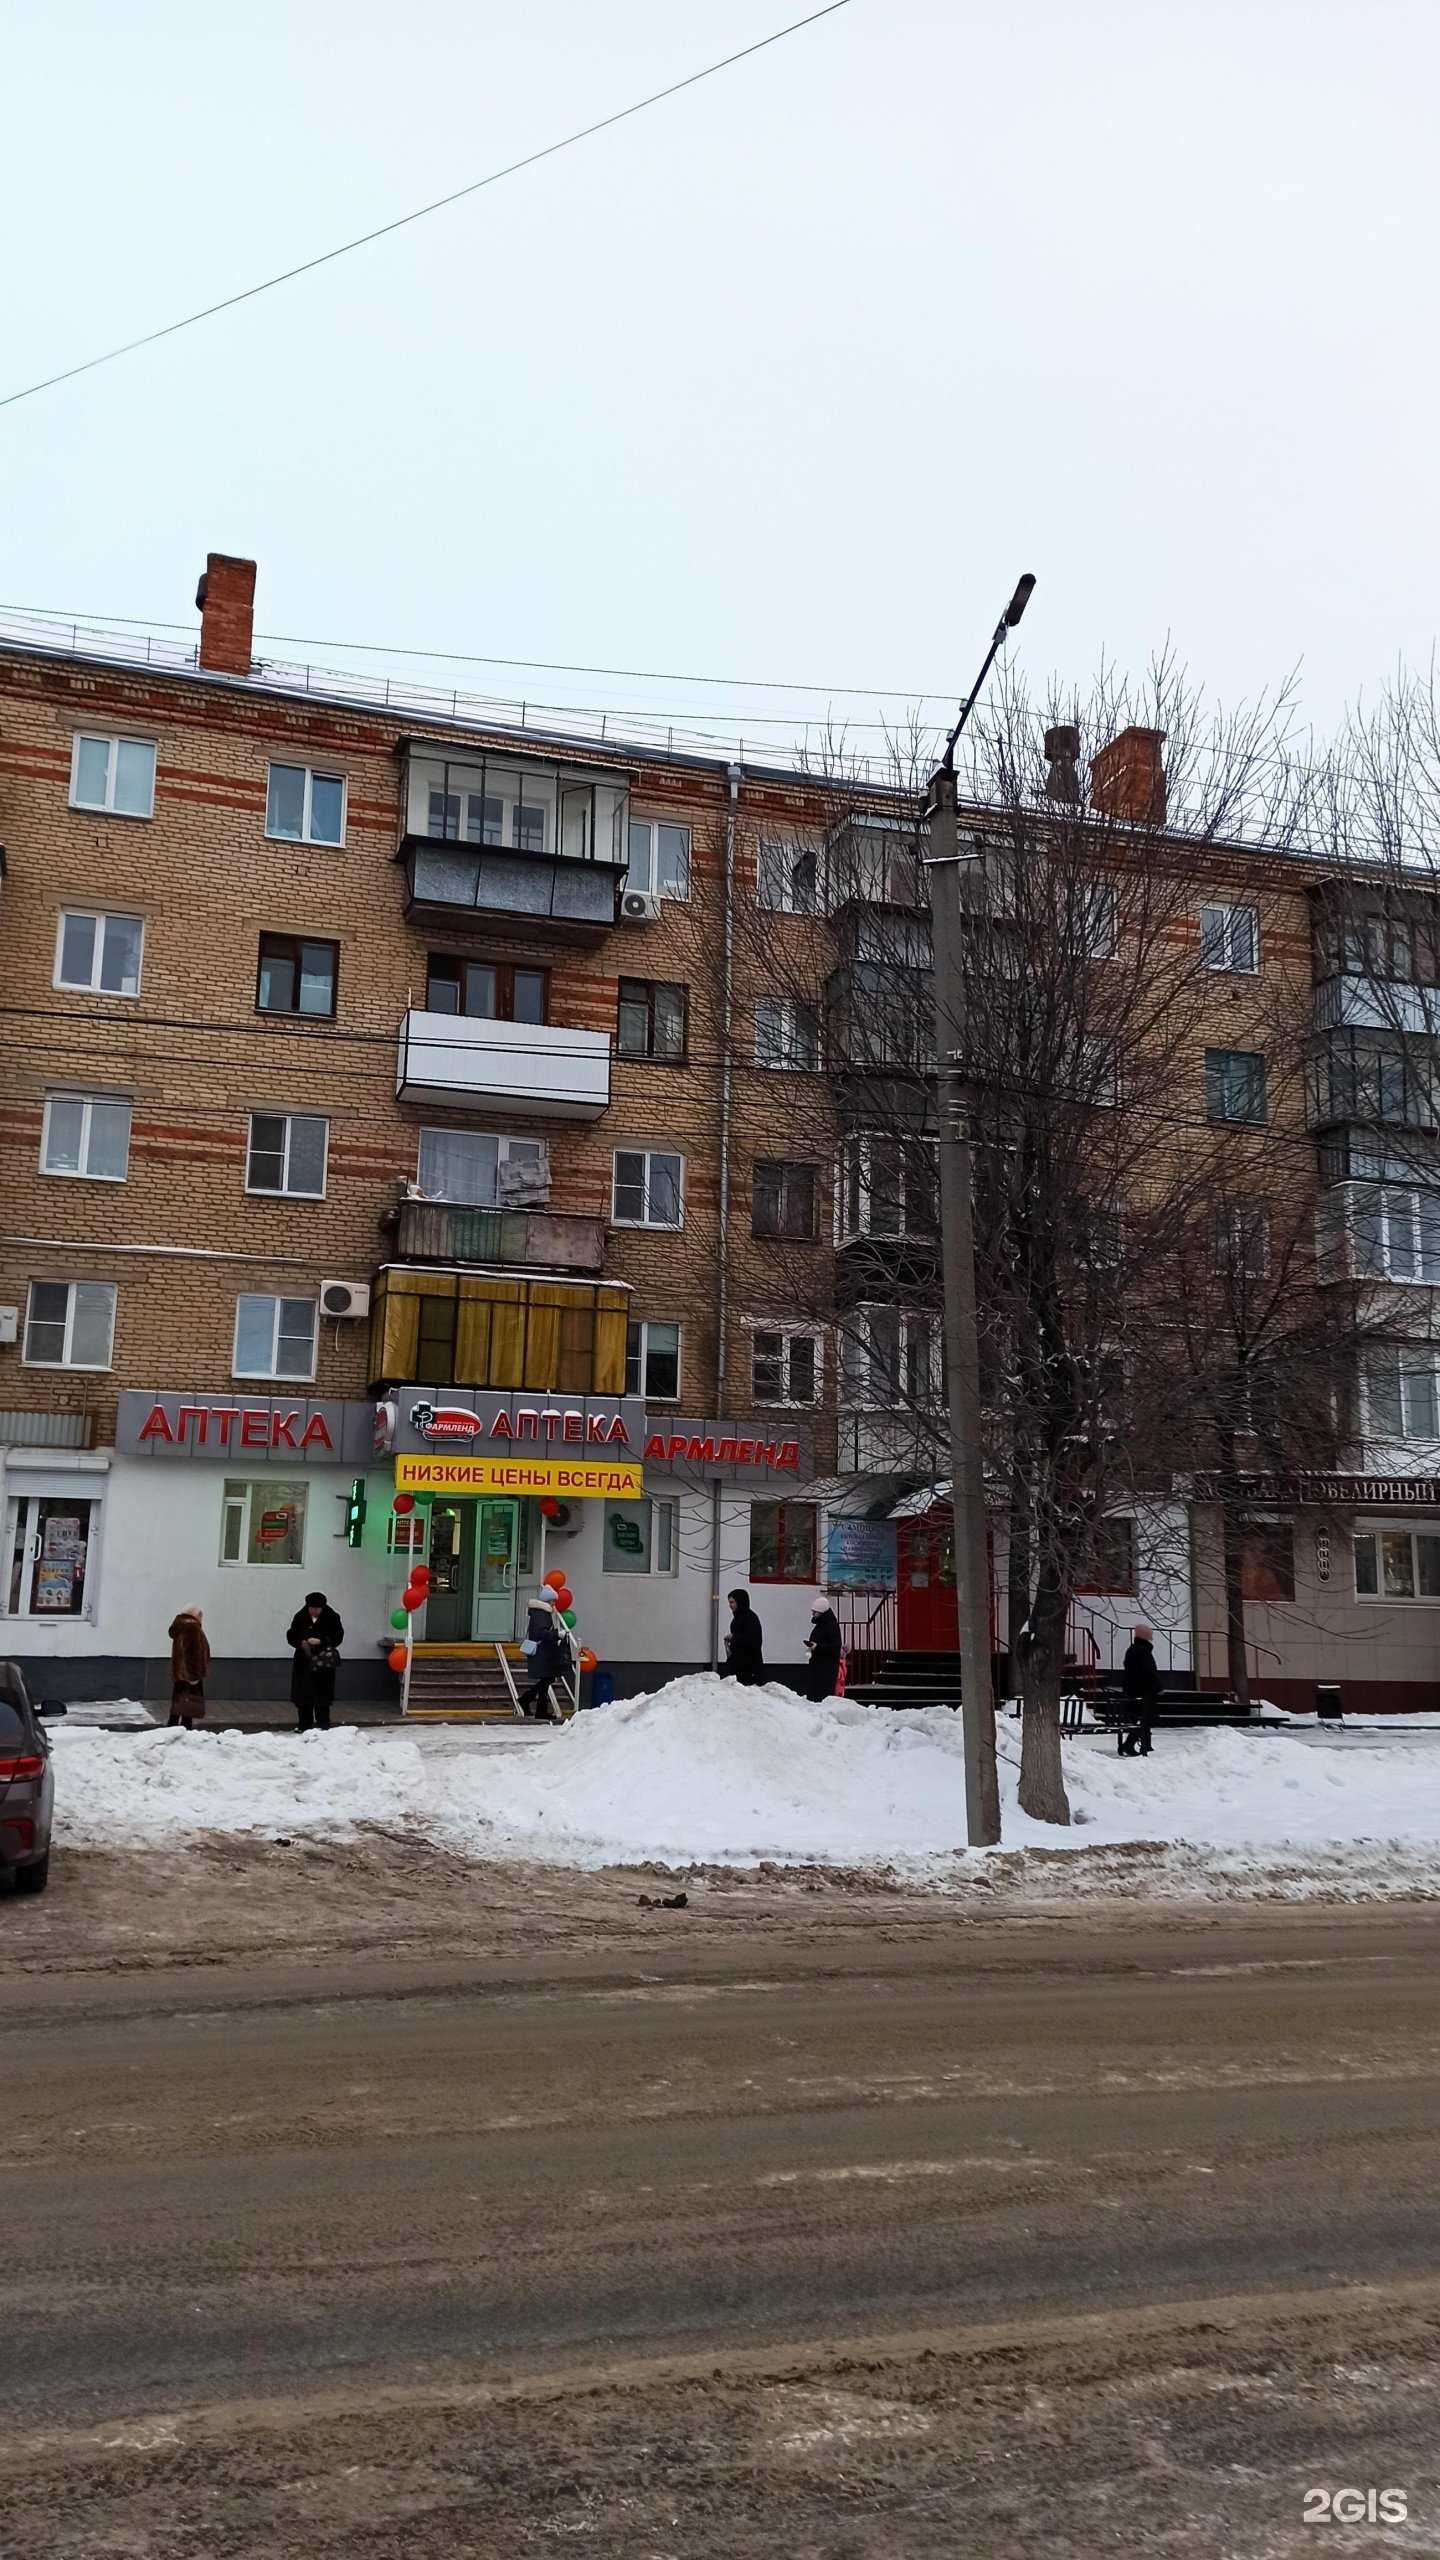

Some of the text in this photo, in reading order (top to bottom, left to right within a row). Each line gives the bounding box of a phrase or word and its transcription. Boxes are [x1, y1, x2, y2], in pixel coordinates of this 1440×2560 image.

[138, 1404, 333, 1449] АПТЕКА
[425, 1422, 475, 1433] ФАРМЛЕНД
[489, 1409, 631, 1442] АПТЕКА
[644, 1434, 800, 1470] АРМЛЕНД
[403, 1464, 635, 1490] НИЗКИЕ ЦЕНЫ ВСЕГДА
